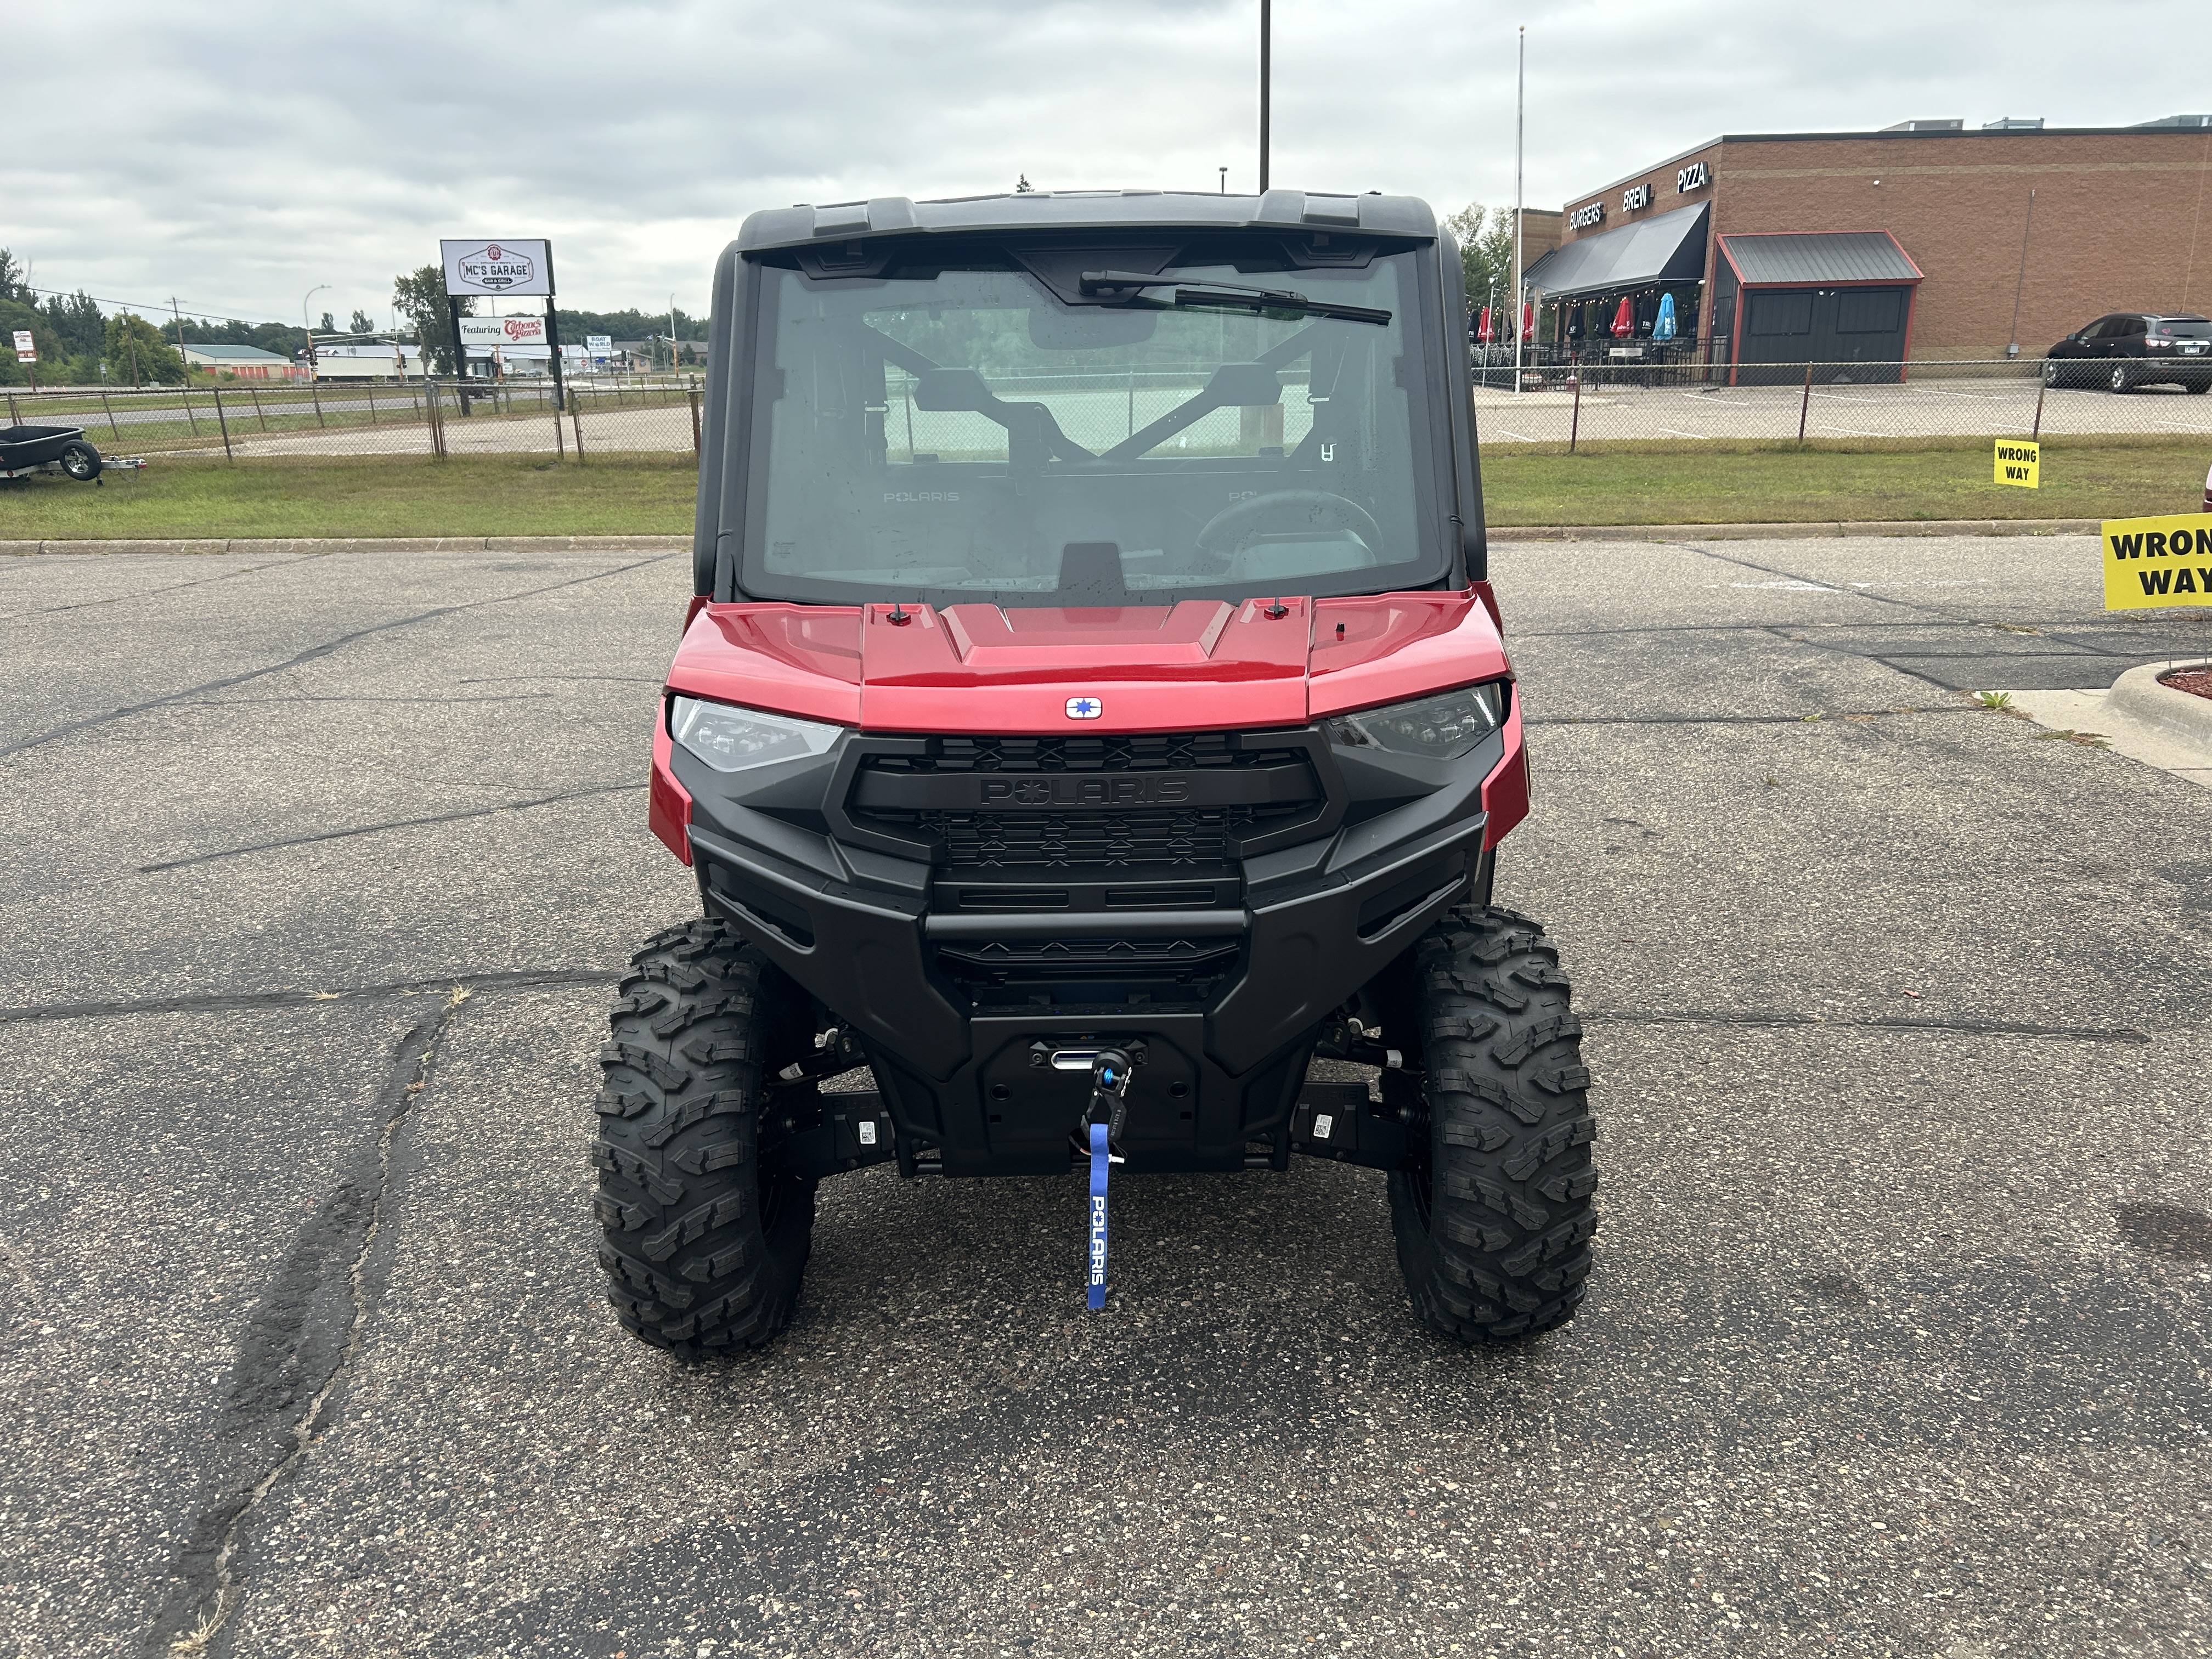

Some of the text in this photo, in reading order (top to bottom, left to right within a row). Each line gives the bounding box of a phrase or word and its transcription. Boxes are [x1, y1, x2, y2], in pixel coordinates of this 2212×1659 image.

[1677, 161, 1706, 194] PIZZA
[1622, 184, 1648, 212] BREW
[1570, 202, 1601, 230] BURGERS
[465, 265, 527, 275] MC'S GARAGE
[461, 325, 501, 336] Featuring
[1997, 447, 2036, 462] WRONG
[2005, 466, 2029, 481] WAY
[883, 492, 960, 503] POLARIS
[2138, 567, 2212, 595] WAY
[980, 776, 1189, 805] POLARIS
[1091, 1196, 1105, 1286] POLARIS
